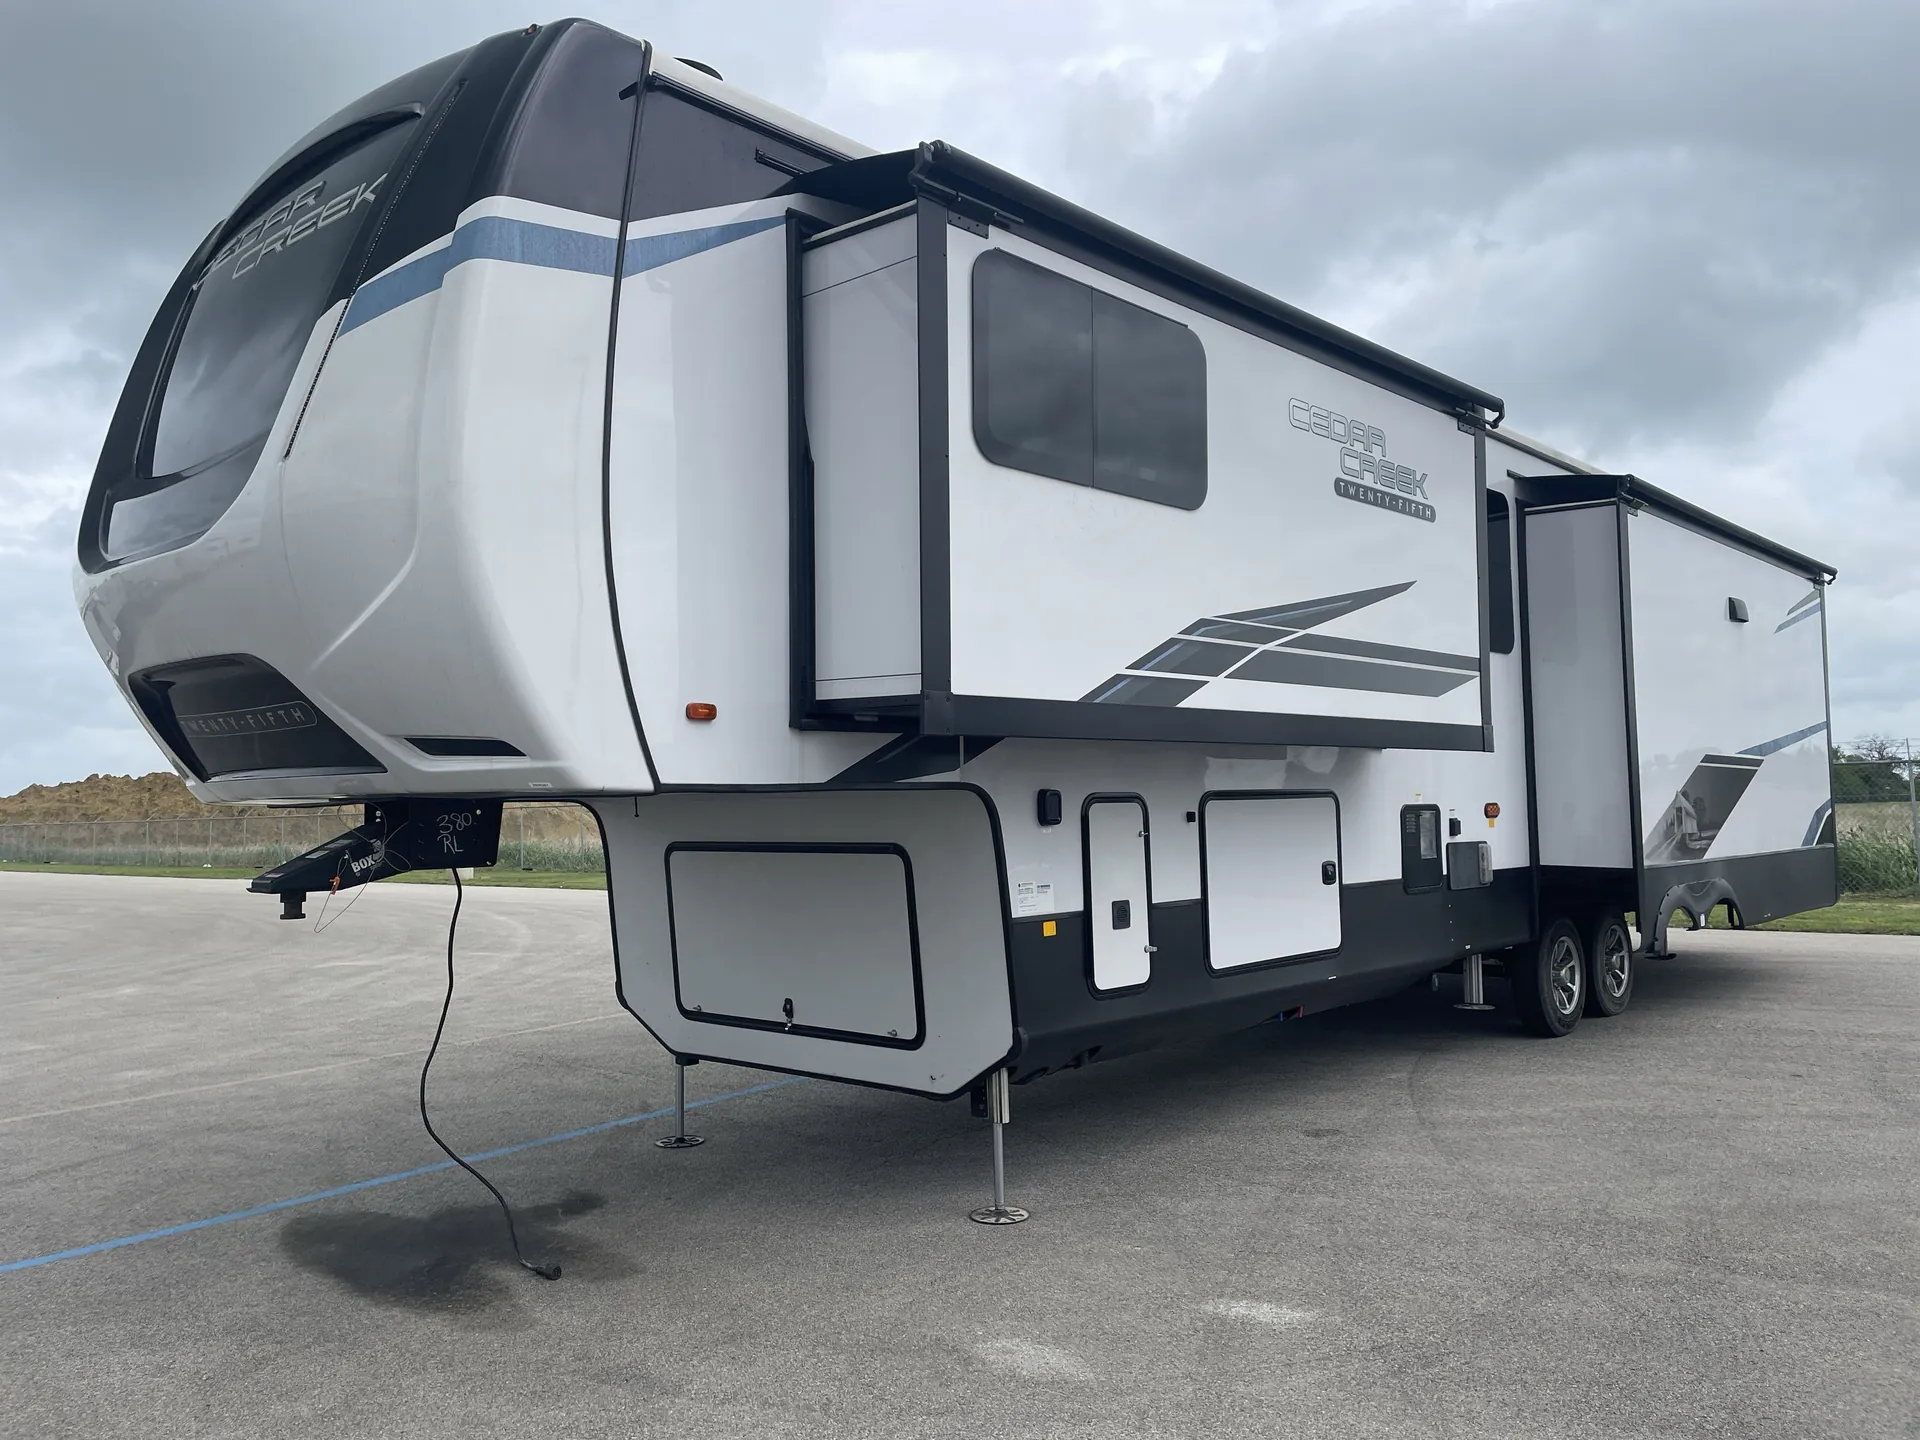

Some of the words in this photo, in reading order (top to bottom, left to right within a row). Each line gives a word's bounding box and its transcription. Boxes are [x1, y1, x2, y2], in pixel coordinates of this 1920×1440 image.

[232, 172, 388, 280] CREEK
[1289, 397, 1386, 458] CEDAR
[1340, 446, 1428, 500] CREEK
[1339, 482, 1431, 519] TWENTY-FIFTH
[436, 813, 472, 834] 380
[437, 834, 464, 855] RL
[351, 854, 376, 873] BOX
